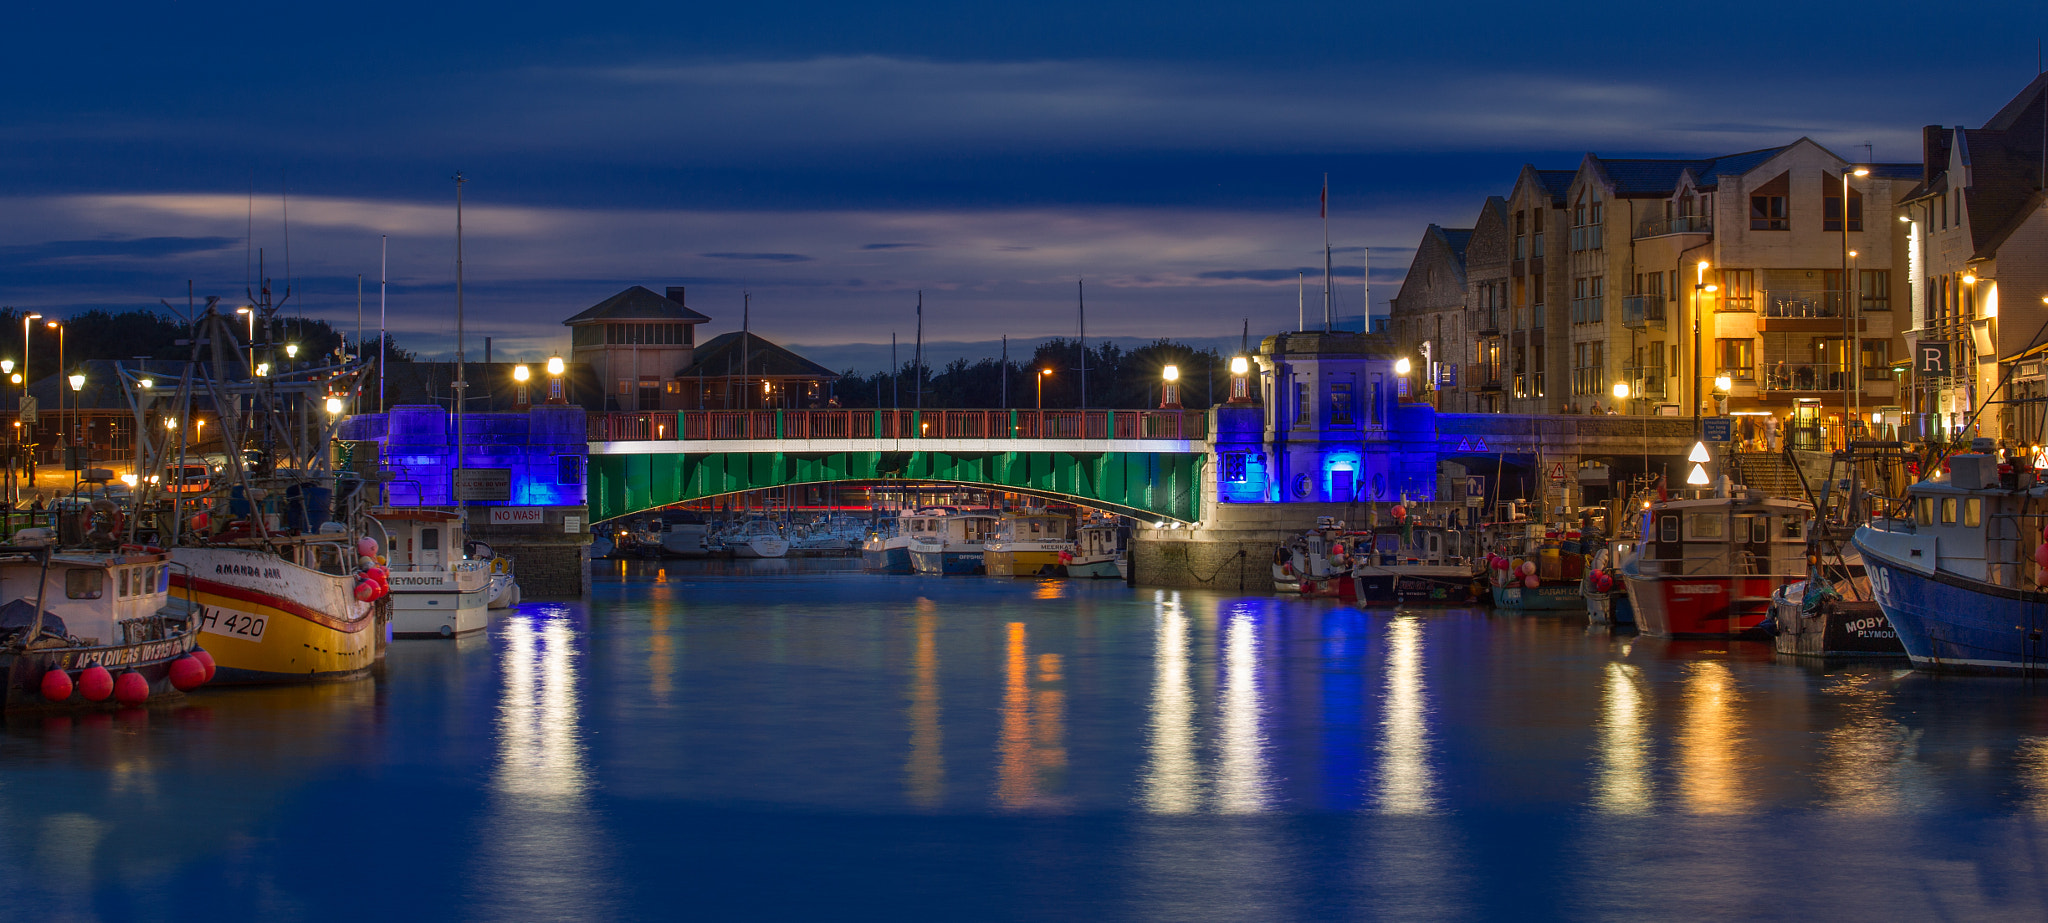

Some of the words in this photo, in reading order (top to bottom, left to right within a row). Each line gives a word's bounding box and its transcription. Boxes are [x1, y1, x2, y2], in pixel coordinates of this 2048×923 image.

[1922, 347, 1944, 372] R
[495, 510, 511, 521] NO
[513, 510, 541, 521] WASH
[215, 563, 262, 578] AMANDA
[388, 576, 444, 586] WEYMOUTH
[1538, 587, 1567, 596] SARAH
[224, 614, 265, 636] 420
[1845, 617, 1884, 633] MOBY
[104, 647, 139, 665] DIVERS
